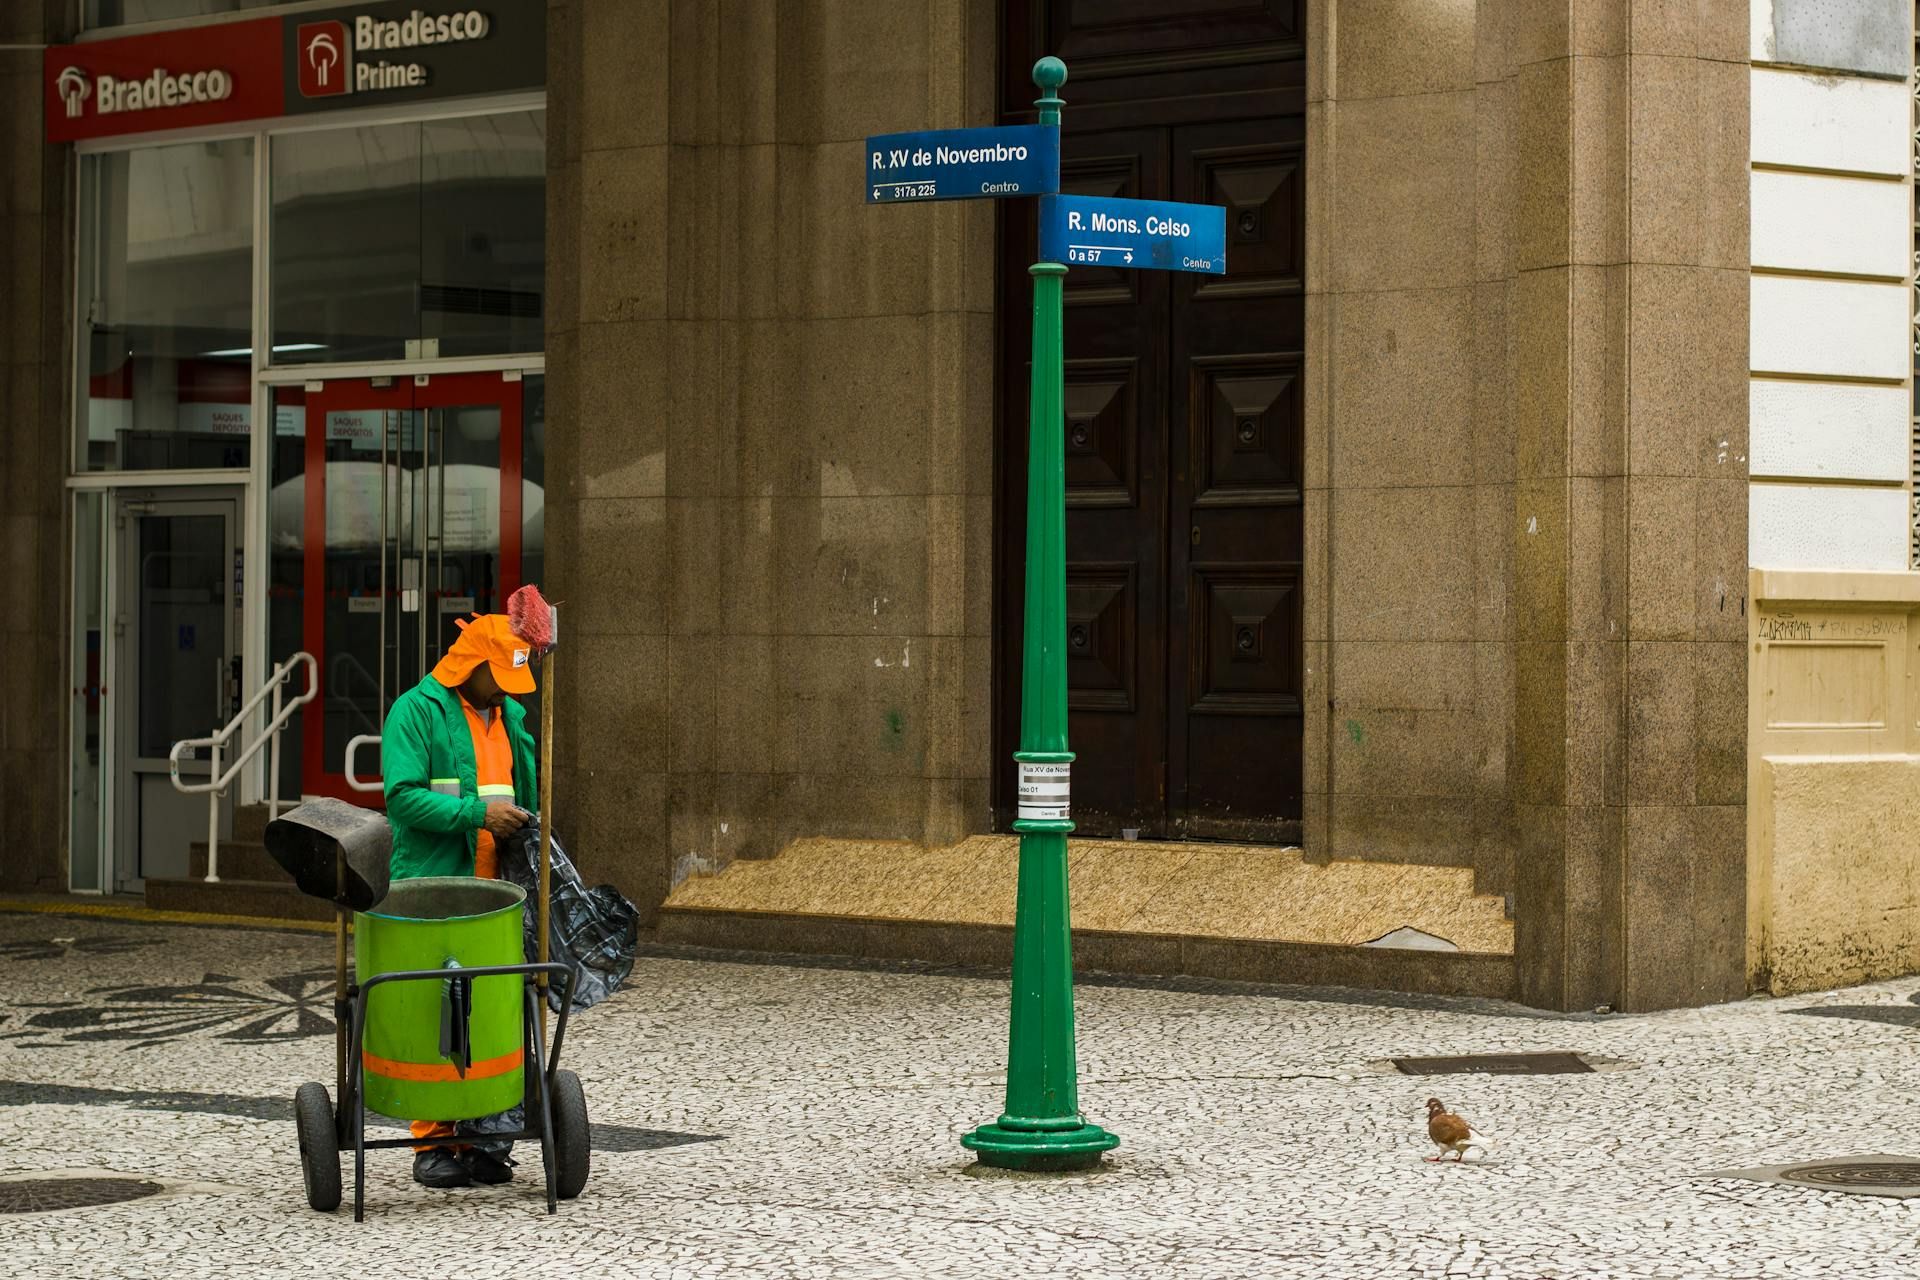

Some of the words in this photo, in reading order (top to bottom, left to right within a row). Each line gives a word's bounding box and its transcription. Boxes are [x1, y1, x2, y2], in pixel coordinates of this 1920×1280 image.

[355, 10, 489, 51] Bradesco
[356, 61, 427, 91] Prime
[96, 68, 233, 114] Bradesco
[872, 152, 886, 170] R.
[889, 150, 909, 169] XV
[912, 148, 932, 167] de
[936, 143, 1028, 165] Novembro
[918, 185, 936, 196] 225
[981, 181, 1020, 193] Centro
[1068, 211, 1087, 231] R.
[1091, 213, 1142, 235] Mons.
[1146, 216, 1191, 238] Celso
[1069, 249, 1077, 261] 0
[1078, 252, 1086, 261] a
[1087, 250, 1101, 262] 57
[1182, 256, 1212, 270] Centro
